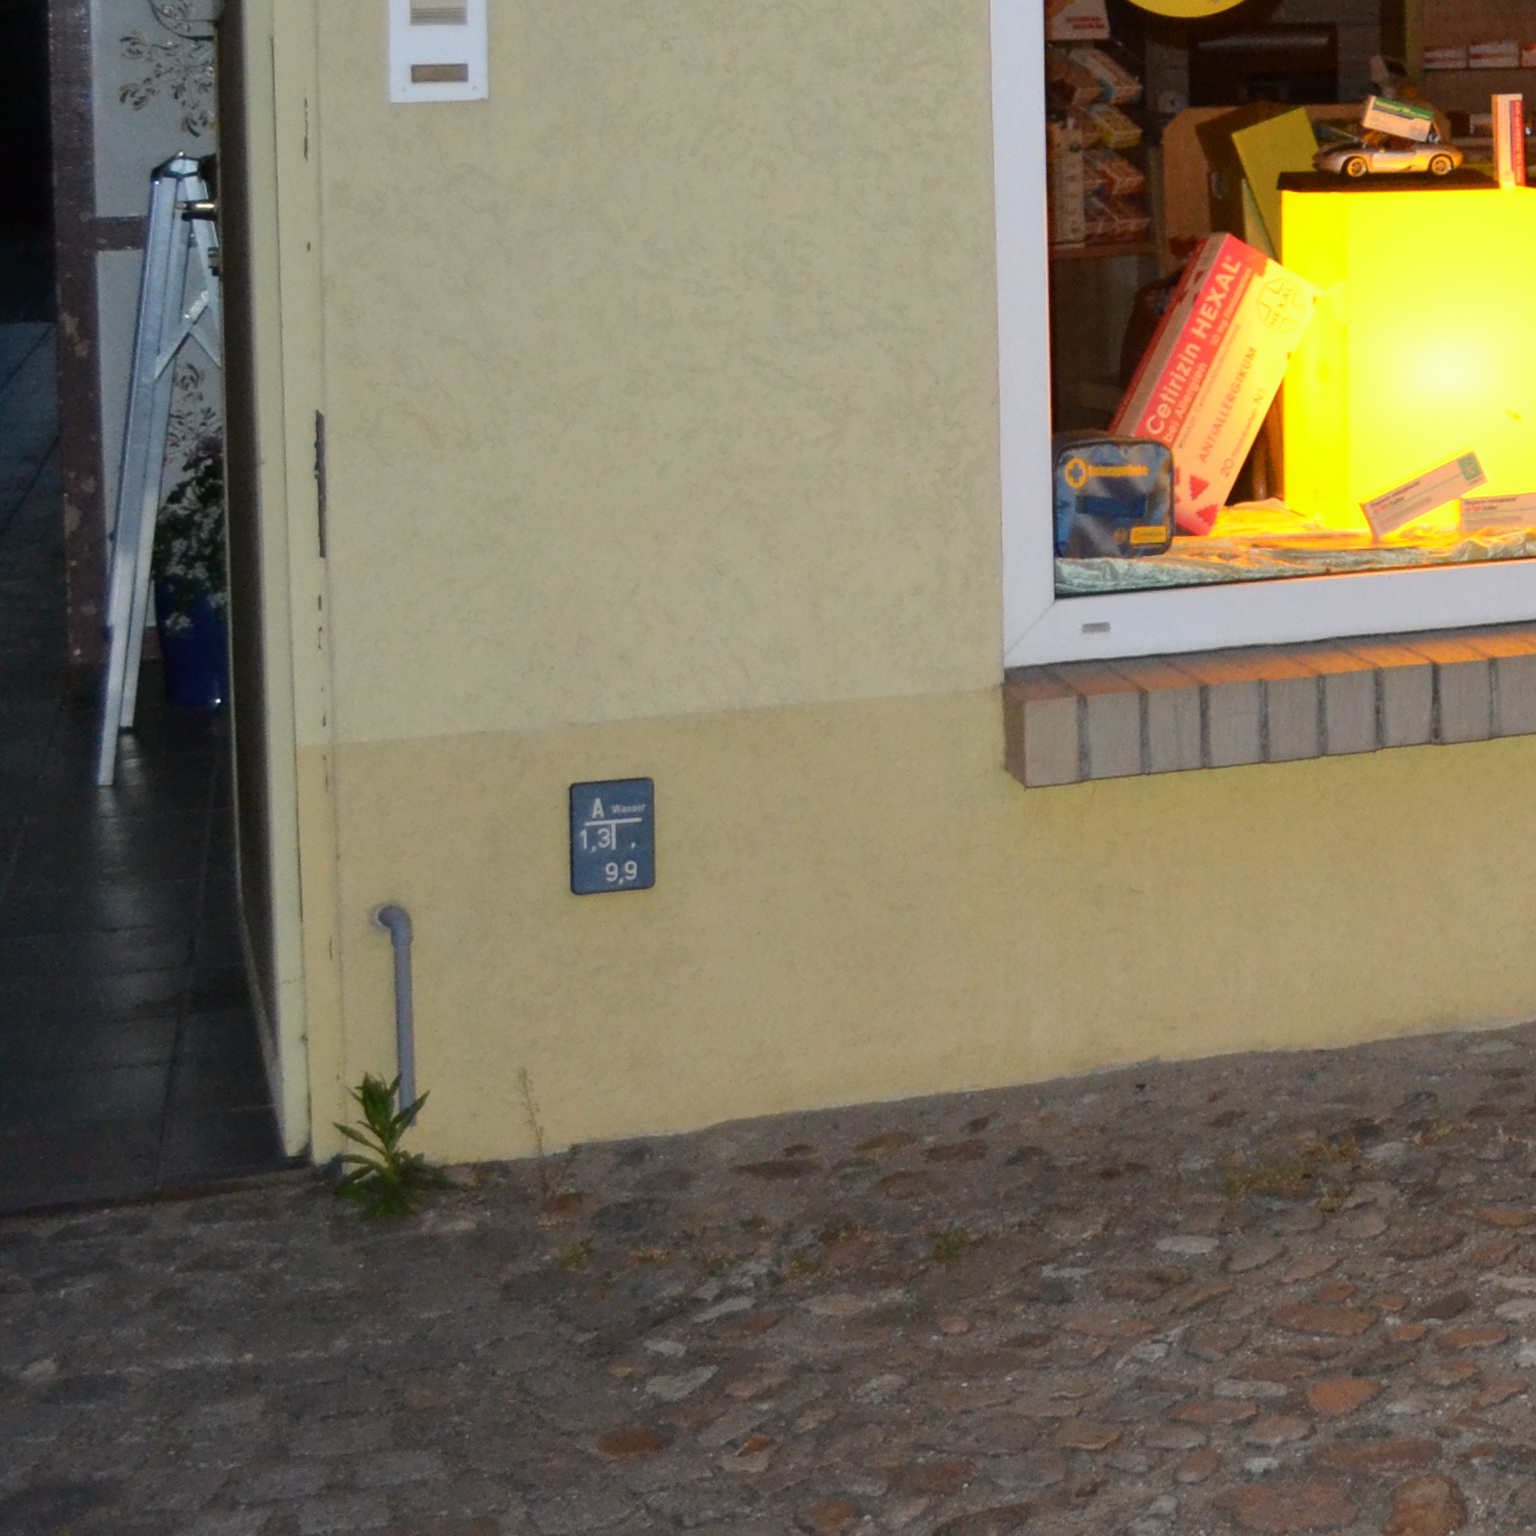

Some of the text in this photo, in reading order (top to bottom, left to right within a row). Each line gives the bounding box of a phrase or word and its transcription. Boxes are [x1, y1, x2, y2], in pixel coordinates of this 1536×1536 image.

[1146, 342, 1201, 436] Cetirizin
[1164, 361, 1208, 442] bei Allergien
[1198, 347, 1259, 463] ANTIALLERGIKUM
[591, 798, 605, 818] A
[605, 860, 638, 884] 9,9
